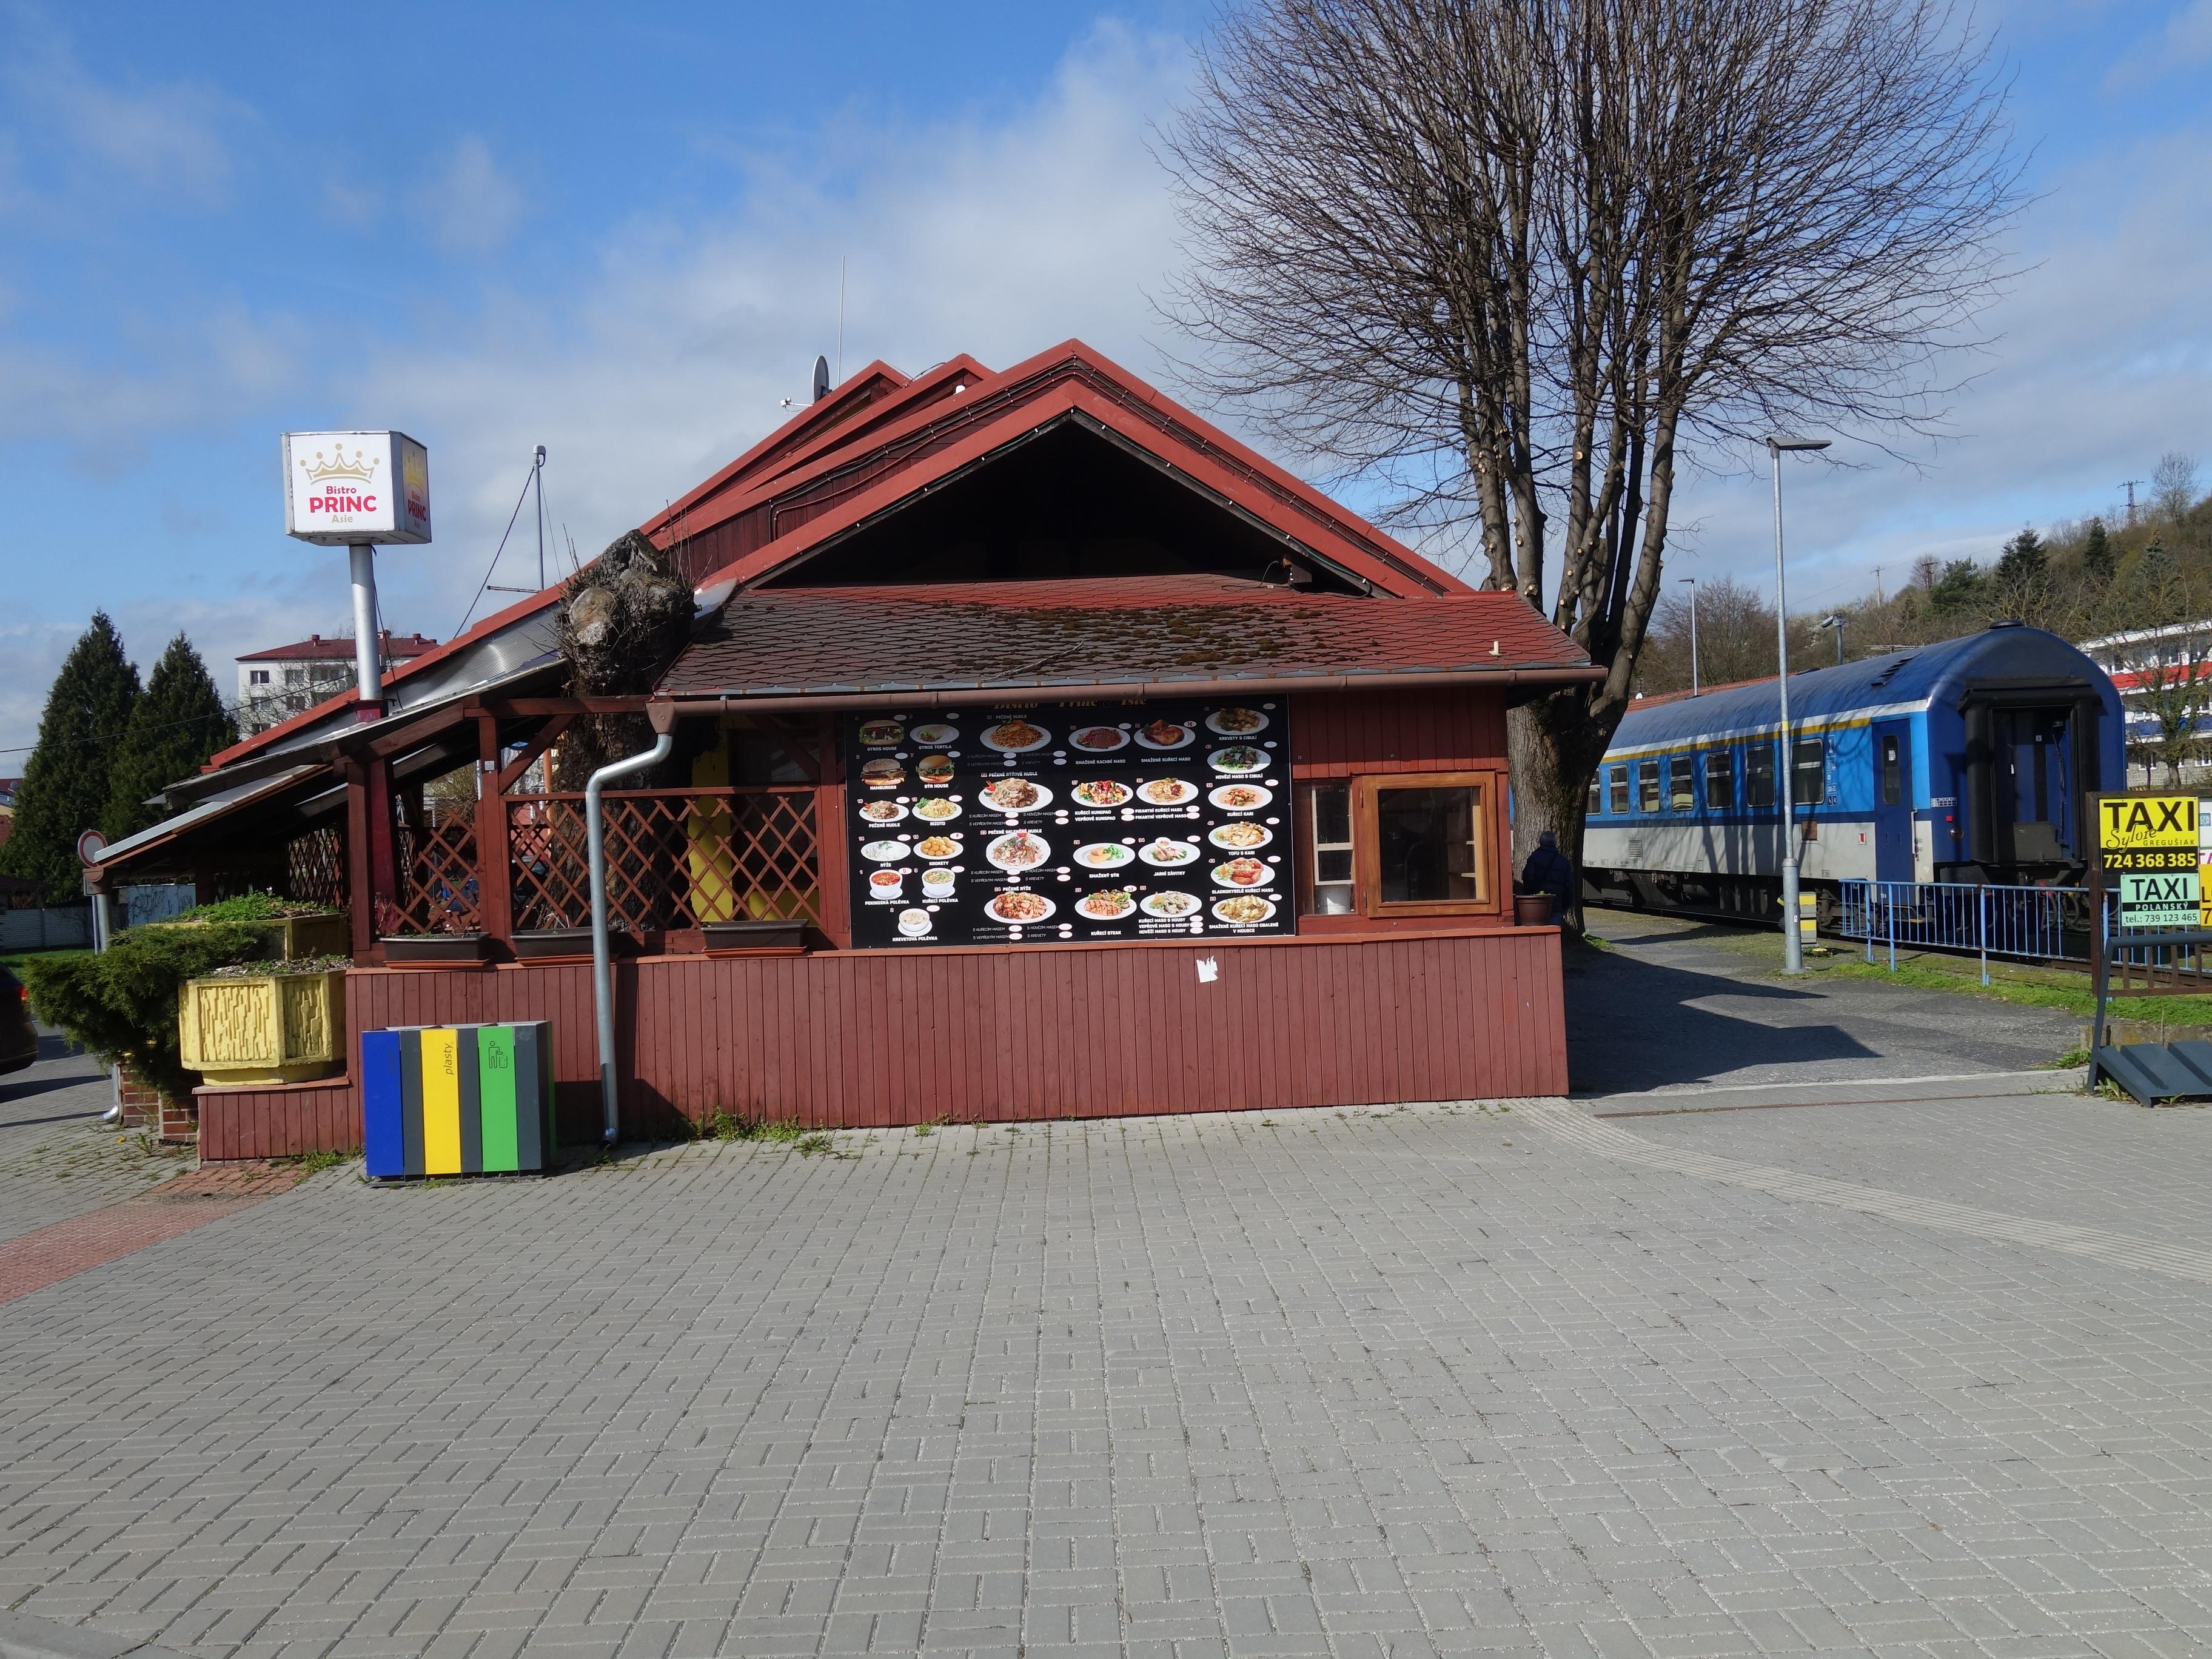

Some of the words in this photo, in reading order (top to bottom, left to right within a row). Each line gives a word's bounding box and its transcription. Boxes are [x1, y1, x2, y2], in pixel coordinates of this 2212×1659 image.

[326, 486, 357, 495] Bistro
[309, 495, 377, 513] PRINC
[407, 499, 426, 522] PRINC
[332, 514, 353, 523] Asie
[2103, 801, 2194, 833] TAXI
[2106, 823, 2157, 853] Sylvie
[2103, 854, 2133, 868] 724
[2136, 854, 2165, 867] 368
[2168, 853, 2196, 867] 385
[2130, 877, 2188, 900] TAXI
[2202, 886, 2212, 902] L
[2136, 902, 2188, 911] POLANSKÝ
[2125, 915, 2142, 923] tel.:
[443, 1043, 454, 1075] plasty
